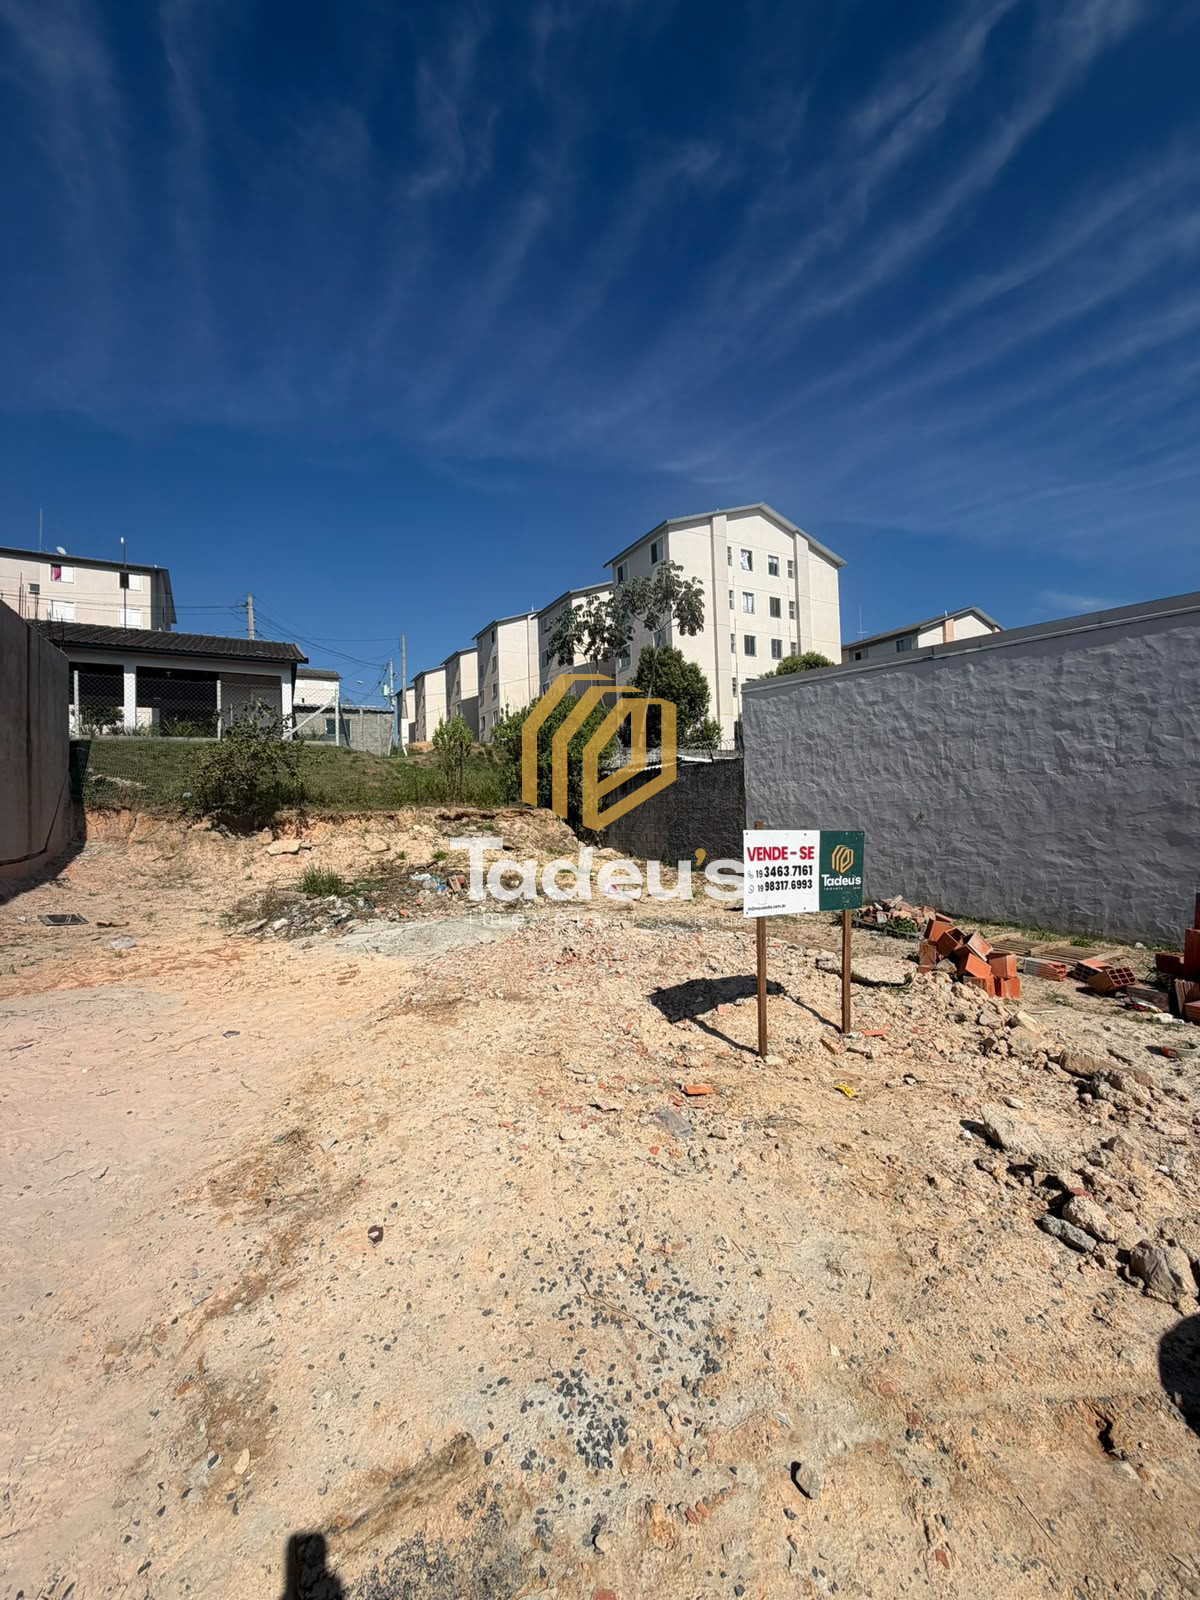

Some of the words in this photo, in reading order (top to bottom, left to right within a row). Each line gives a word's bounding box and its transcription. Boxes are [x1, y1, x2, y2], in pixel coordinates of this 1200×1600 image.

[756, 869, 763, 878] 19
[764, 865, 813, 878] 3463.7161
[757, 884, 764, 892] 19
[765, 879, 813, 892] 98317.6993
